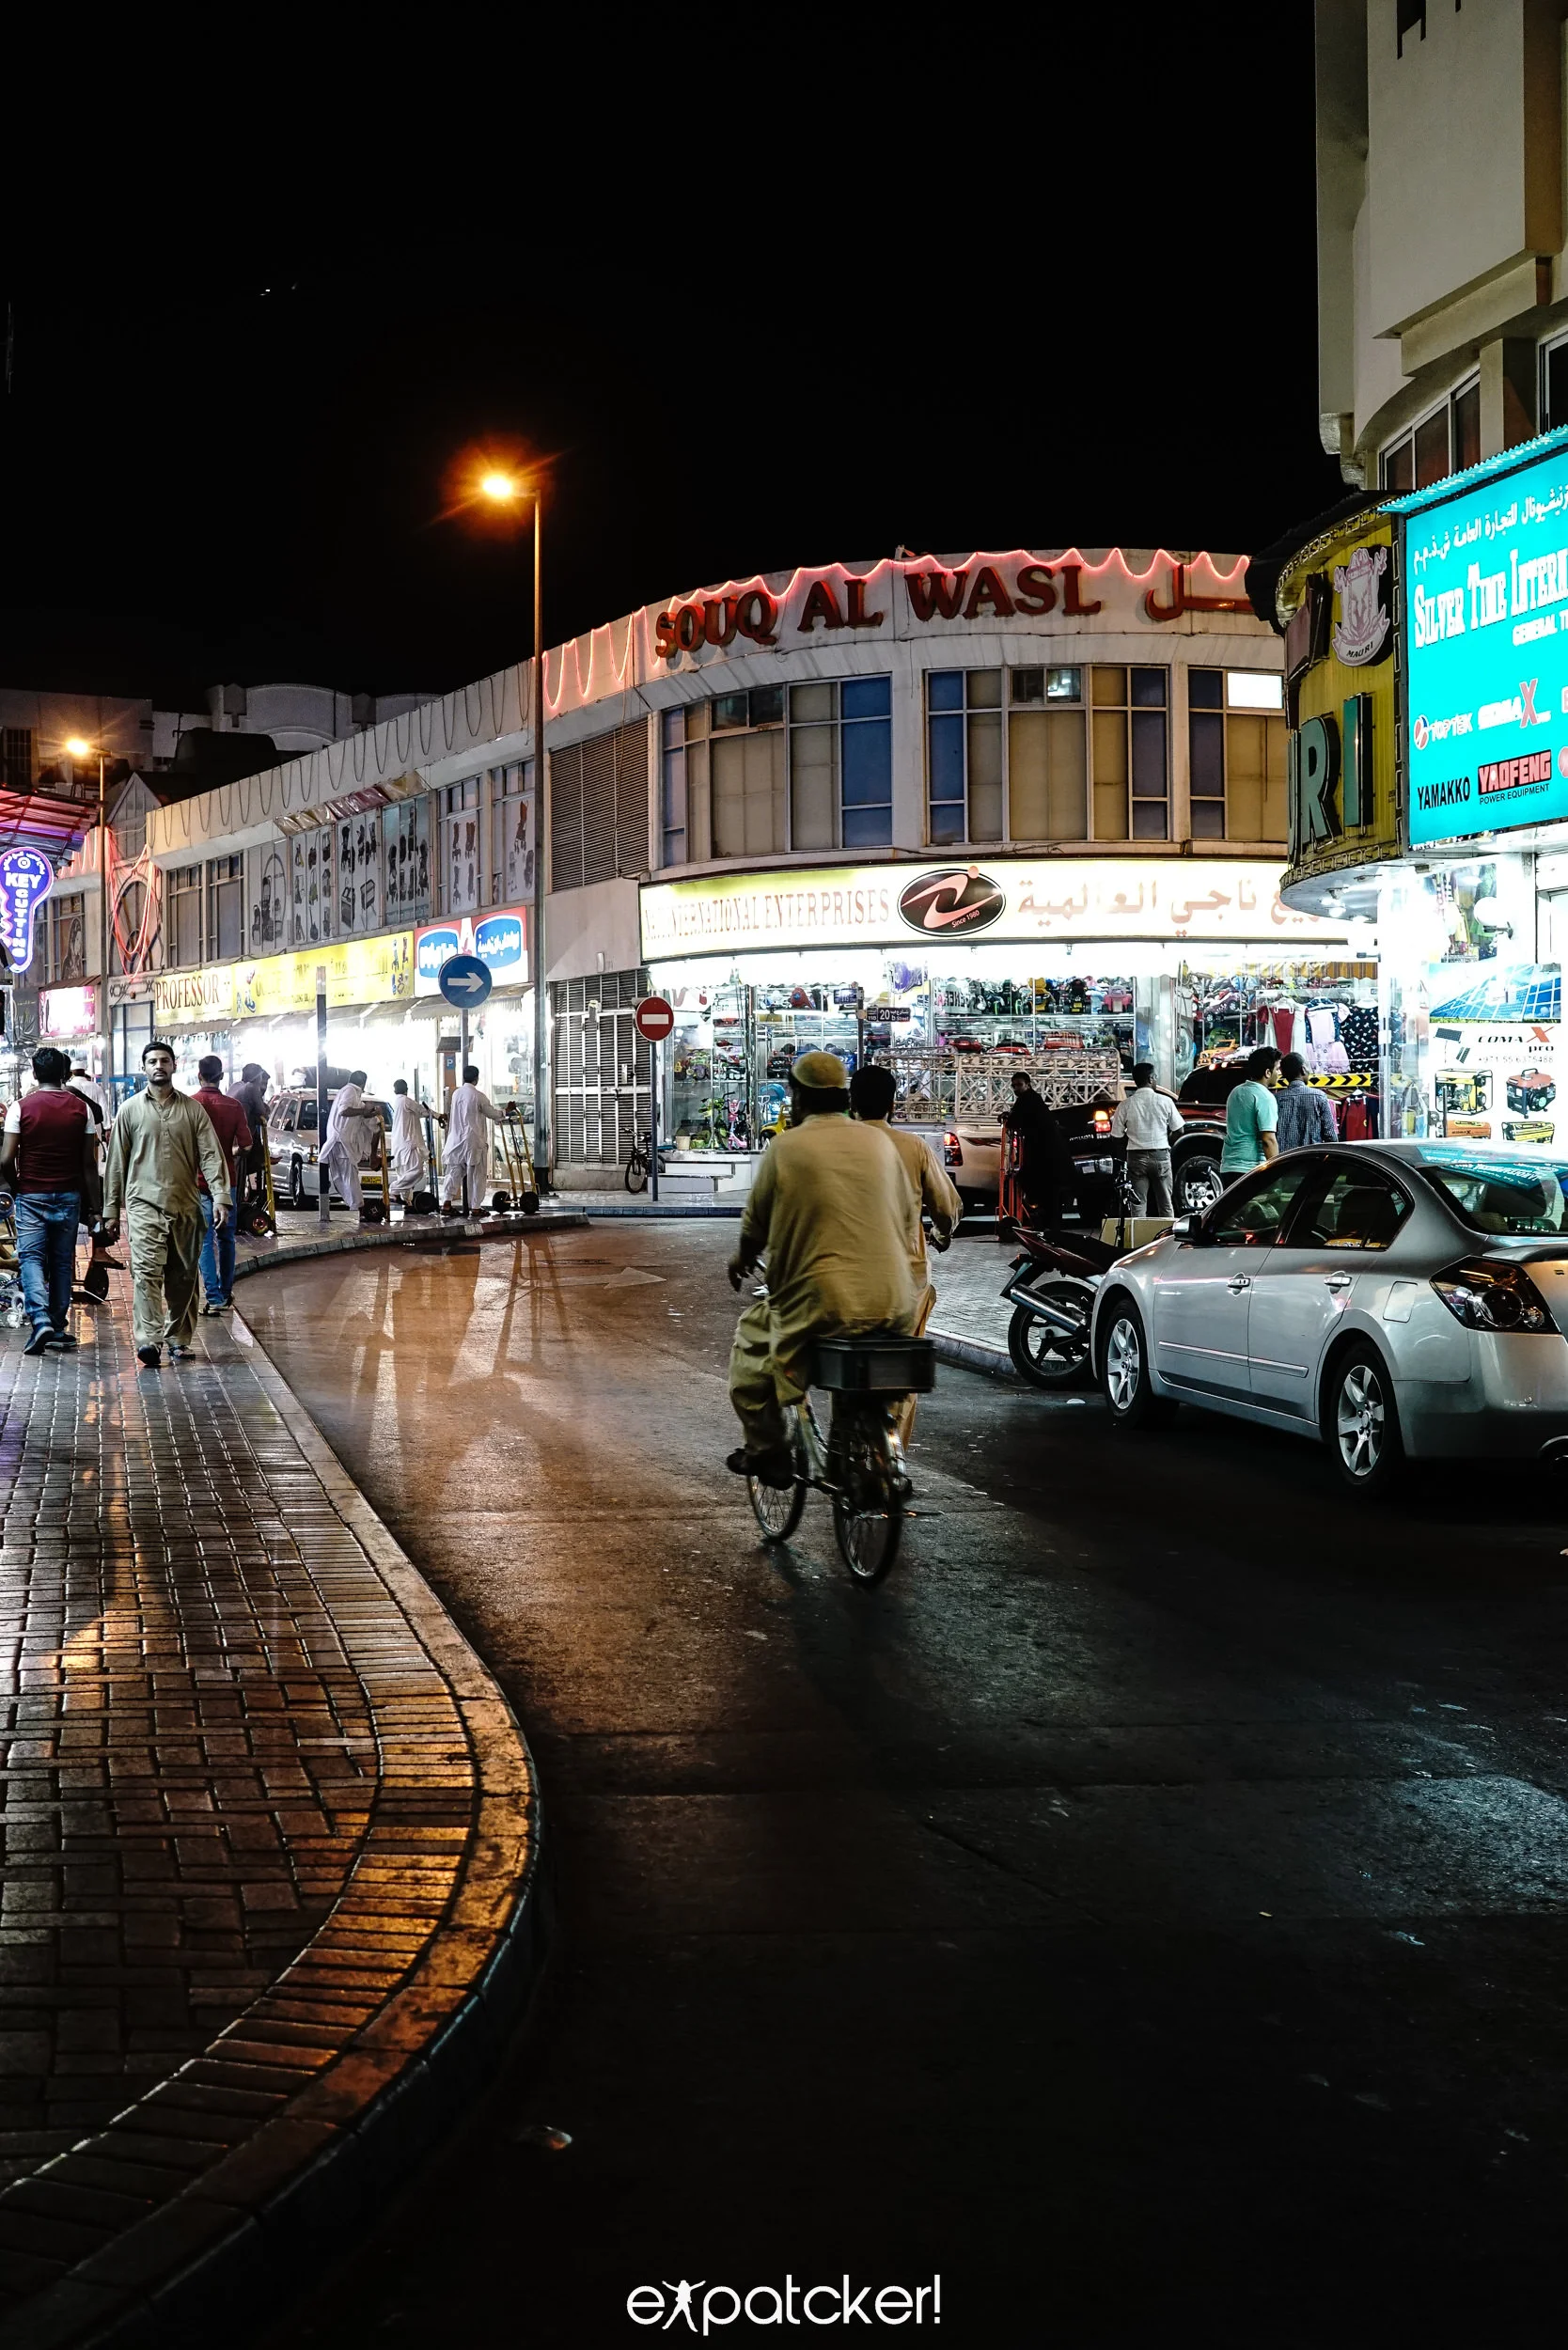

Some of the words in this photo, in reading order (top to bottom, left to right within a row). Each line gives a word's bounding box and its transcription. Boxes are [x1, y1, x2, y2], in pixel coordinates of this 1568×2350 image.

[1452, 518, 1482, 548] العامة
[1484, 502, 1518, 540] للتجارة
[655, 589, 778, 658] SOUQ
[796, 578, 884, 633] AL
[903, 564, 1102, 622] WASL
[1346, 640, 1374, 658] MAURI
[1478, 750, 1551, 794] YAOFENG
[1418, 776, 1470, 810] YAMAKKO
[1479, 791, 1506, 806] POWER
[1508, 783, 1550, 800] EQUIPMENT
[5, 871, 42, 889] KEY
[11, 888, 29, 958] CUTTING
[764, 888, 890, 929] ENTERPRISES
[951, 916, 966, 929] Since
[965, 909, 980, 921] 1980
[1170, 878, 1257, 937] ناجي
[156, 973, 220, 1010] PROFESSOR
[879, 1009, 890, 1021] 20
